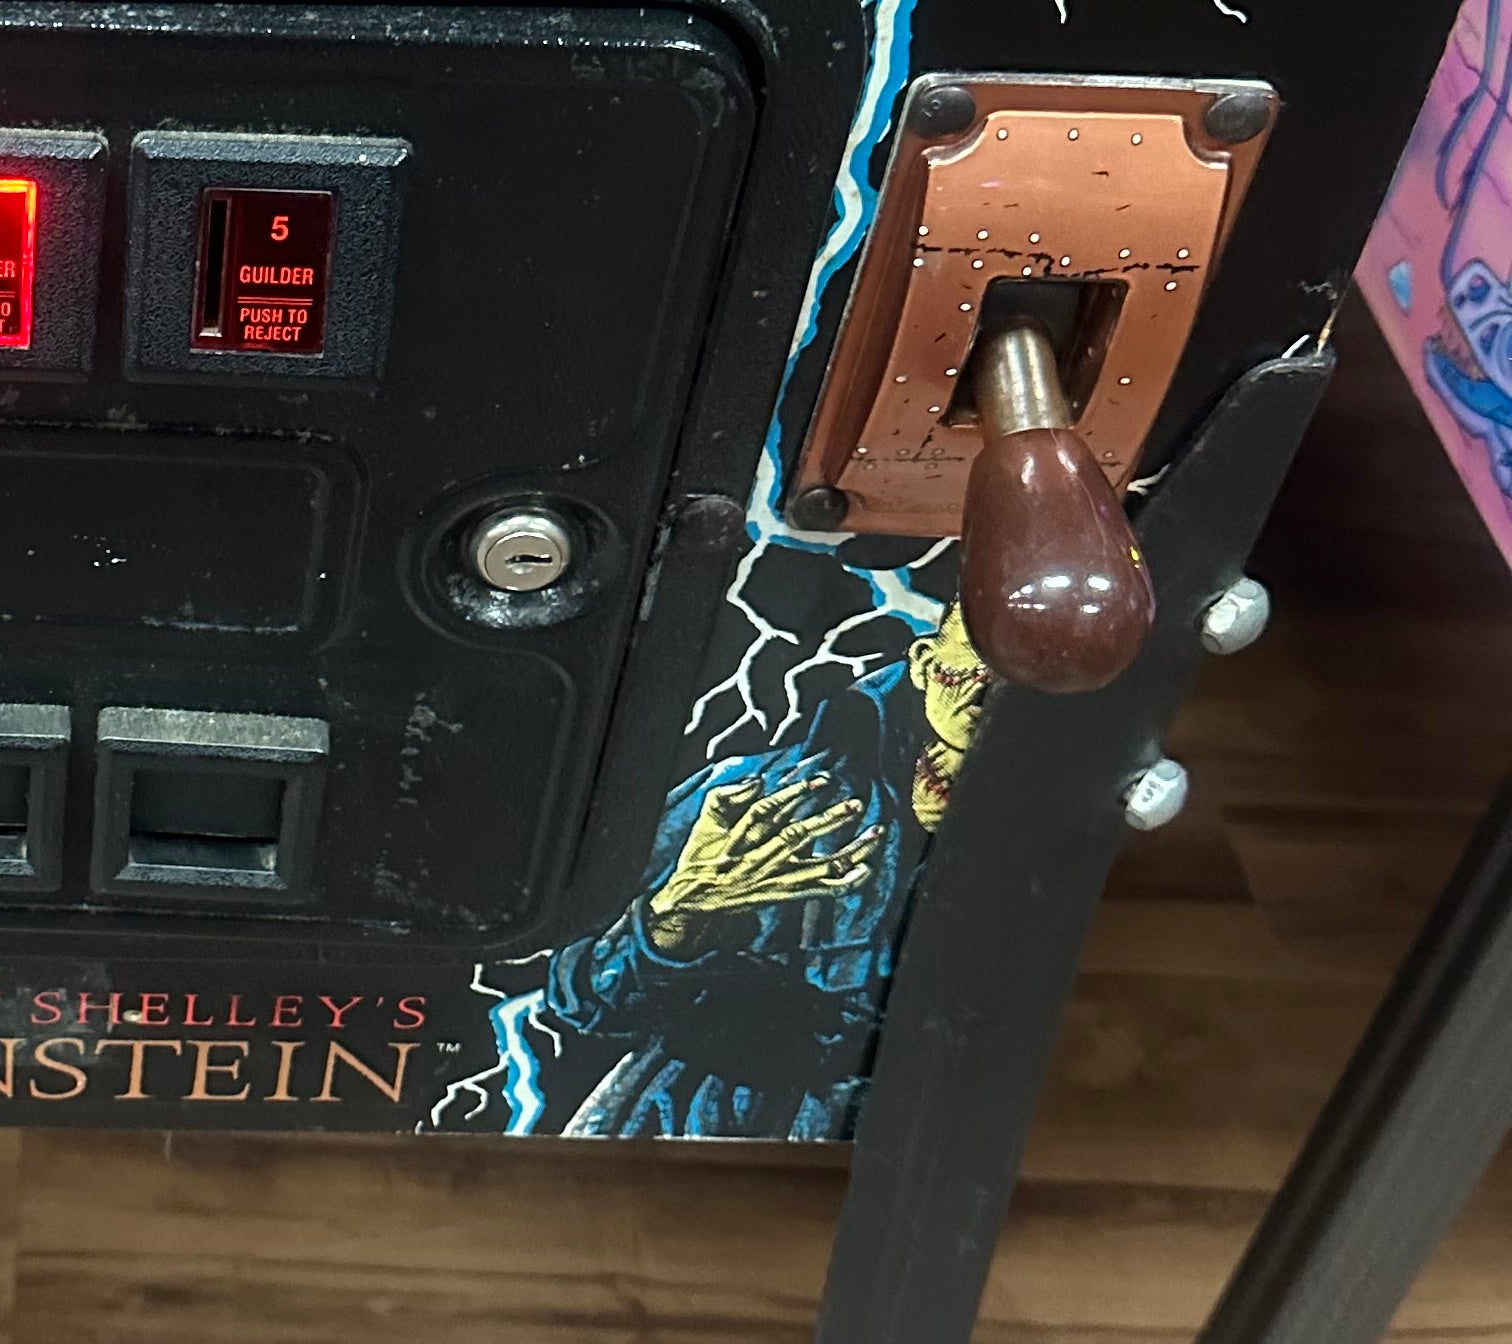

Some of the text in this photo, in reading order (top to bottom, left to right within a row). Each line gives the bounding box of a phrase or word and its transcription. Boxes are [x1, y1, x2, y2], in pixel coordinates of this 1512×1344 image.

[270, 215, 290, 241] 5
[239, 265, 314, 286] GUILDER
[239, 307, 308, 324] PUSH TO
[244, 325, 302, 342] REJECT
[30, 991, 428, 1030] SHELLEY'S
